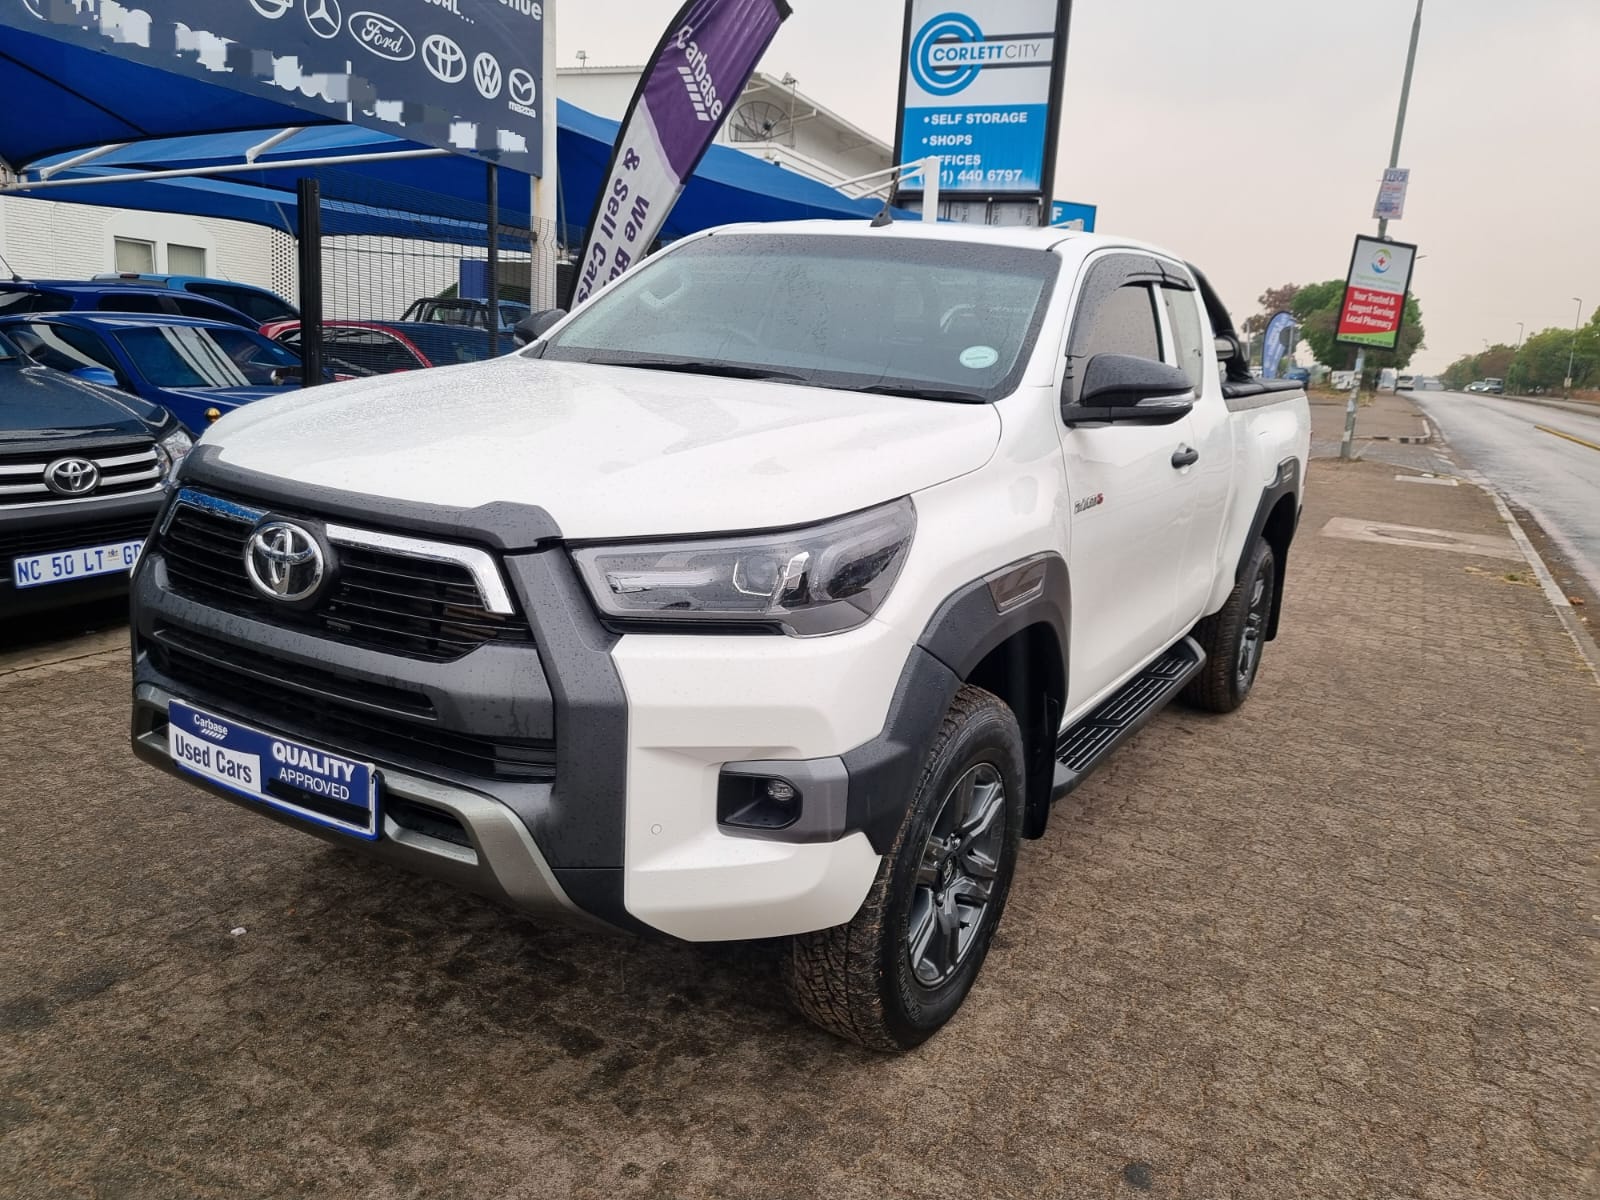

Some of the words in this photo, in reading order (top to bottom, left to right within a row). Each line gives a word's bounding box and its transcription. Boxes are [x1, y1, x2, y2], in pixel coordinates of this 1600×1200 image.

[361, 17, 404, 53] Ford
[676, 24, 723, 121] Carbase
[508, 101, 536, 118] mazda
[930, 113, 963, 125] SELF
[965, 111, 1029, 124] STORAGE
[929, 134, 973, 146] SHOPS
[622, 147, 641, 172] &
[938, 154, 982, 166] FICES
[957, 169, 984, 181] 440
[987, 169, 1023, 182] 6797
[600, 178, 629, 240] Sell
[624, 195, 650, 243] We
[577, 242, 607, 304] Cars
[603, 246, 632, 287] Bu
[1345, 313, 1363, 324] Local
[1362, 315, 1393, 330] Pharmacy
[17, 560, 41, 583] NC
[52, 555, 74, 577] 50
[84, 550, 104, 572] LT
[193, 713, 228, 735] Carbase
[175, 733, 211, 769] Used
[215, 750, 253, 784] Cars
[272, 742, 355, 783] QUALITY
[279, 767, 350, 800] APPROVED
